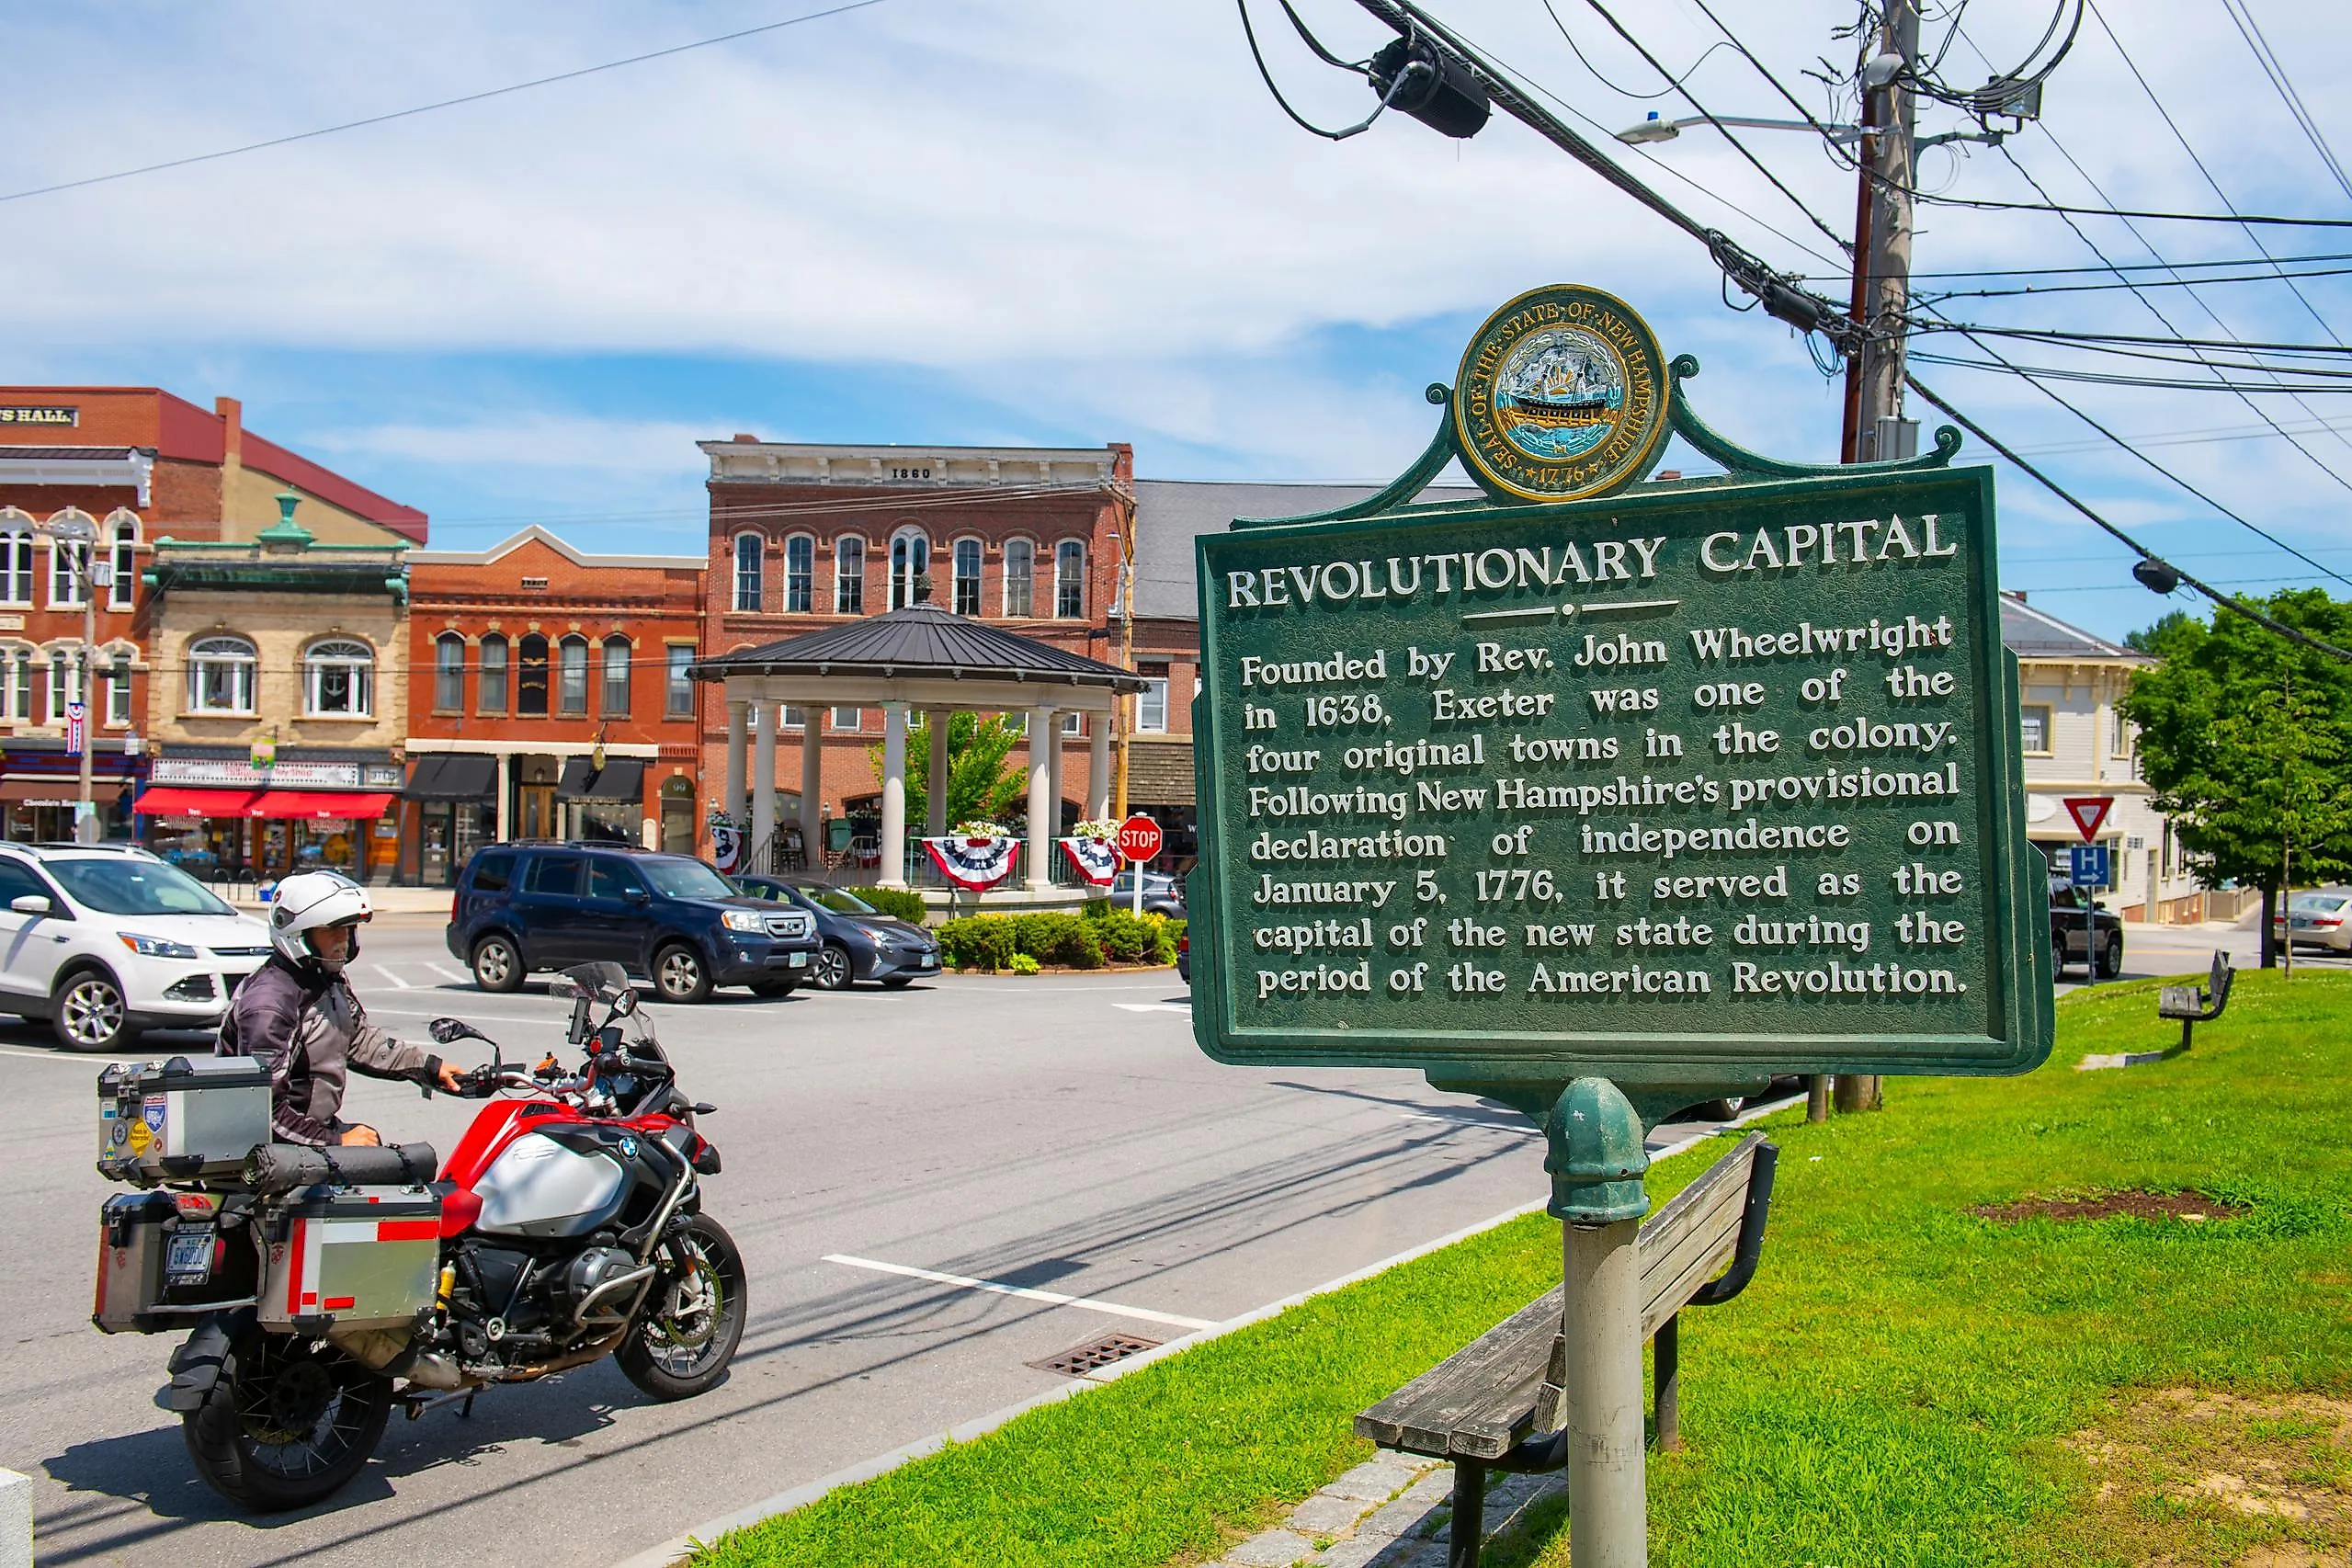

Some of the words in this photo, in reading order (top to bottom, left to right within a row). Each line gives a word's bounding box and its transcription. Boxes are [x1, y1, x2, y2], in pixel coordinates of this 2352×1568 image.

[1501, 302, 1560, 340] STATE
[1568, 301, 1596, 319] OF
[1597, 311, 1639, 350] NEW
[1473, 343, 1502, 382] THE
[0, 410, 15, 422] S
[1471, 389, 1487, 416] OF
[1601, 348, 1652, 463] HAMPSHIRE
[1476, 421, 1518, 470] SEAL
[892, 469, 930, 479] 1860
[1538, 467, 1585, 485] 1776
[1228, 537, 1666, 608] REVOLUTIONARY
[1701, 514, 1958, 572] CAPITAL
[1241, 650, 1387, 686] Founded
[1408, 647, 1455, 681] by
[1476, 643, 1555, 673] Rev.
[1574, 633, 1668, 666] John
[1689, 616, 1952, 660] Wheelwright
[1244, 703, 1277, 730] in
[1306, 694, 1392, 727] 1638,
[1433, 688, 1554, 721] Exeter
[1591, 688, 1658, 712] was
[1695, 683, 1765, 707] one
[1801, 668, 1846, 701] of
[1886, 665, 1955, 698] the
[1246, 744, 1320, 773] four
[1345, 734, 1484, 775] original
[1509, 734, 1619, 763] towns
[1646, 728, 1683, 757] in
[1713, 722, 1780, 755] the
[1809, 717, 1958, 753] colony.
[1249, 786, 1408, 821] Following
[1416, 781, 1487, 812] New
[1495, 774, 1720, 815] Hampshire's
[1729, 762, 1960, 811] provisional
[1120, 830, 1159, 848] STOP
[1252, 830, 1447, 860] declaration
[1493, 825, 1533, 856] of
[1581, 819, 1849, 858] independence
[1908, 822, 1960, 845] on
[2081, 849, 2098, 870] H
[1254, 874, 1396, 908] January
[1417, 869, 1447, 905] 5,
[1476, 869, 1562, 903] 1776,
[1596, 871, 1626, 900] it
[1654, 866, 1788, 899] served
[1818, 873, 1859, 896] as
[1892, 863, 1962, 895] the
[1256, 918, 1373, 955] capital
[1390, 917, 1427, 947] of
[1448, 918, 1506, 947] the
[1526, 925, 1596, 947] new
[1617, 916, 1712, 946] state
[1734, 915, 1869, 953] during
[1894, 912, 1965, 944] the
[1257, 961, 1371, 999] period
[1390, 962, 1428, 992] of
[1448, 962, 1506, 993] the
[1528, 963, 1712, 994] American
[1732, 961, 1968, 993] Revolution.
